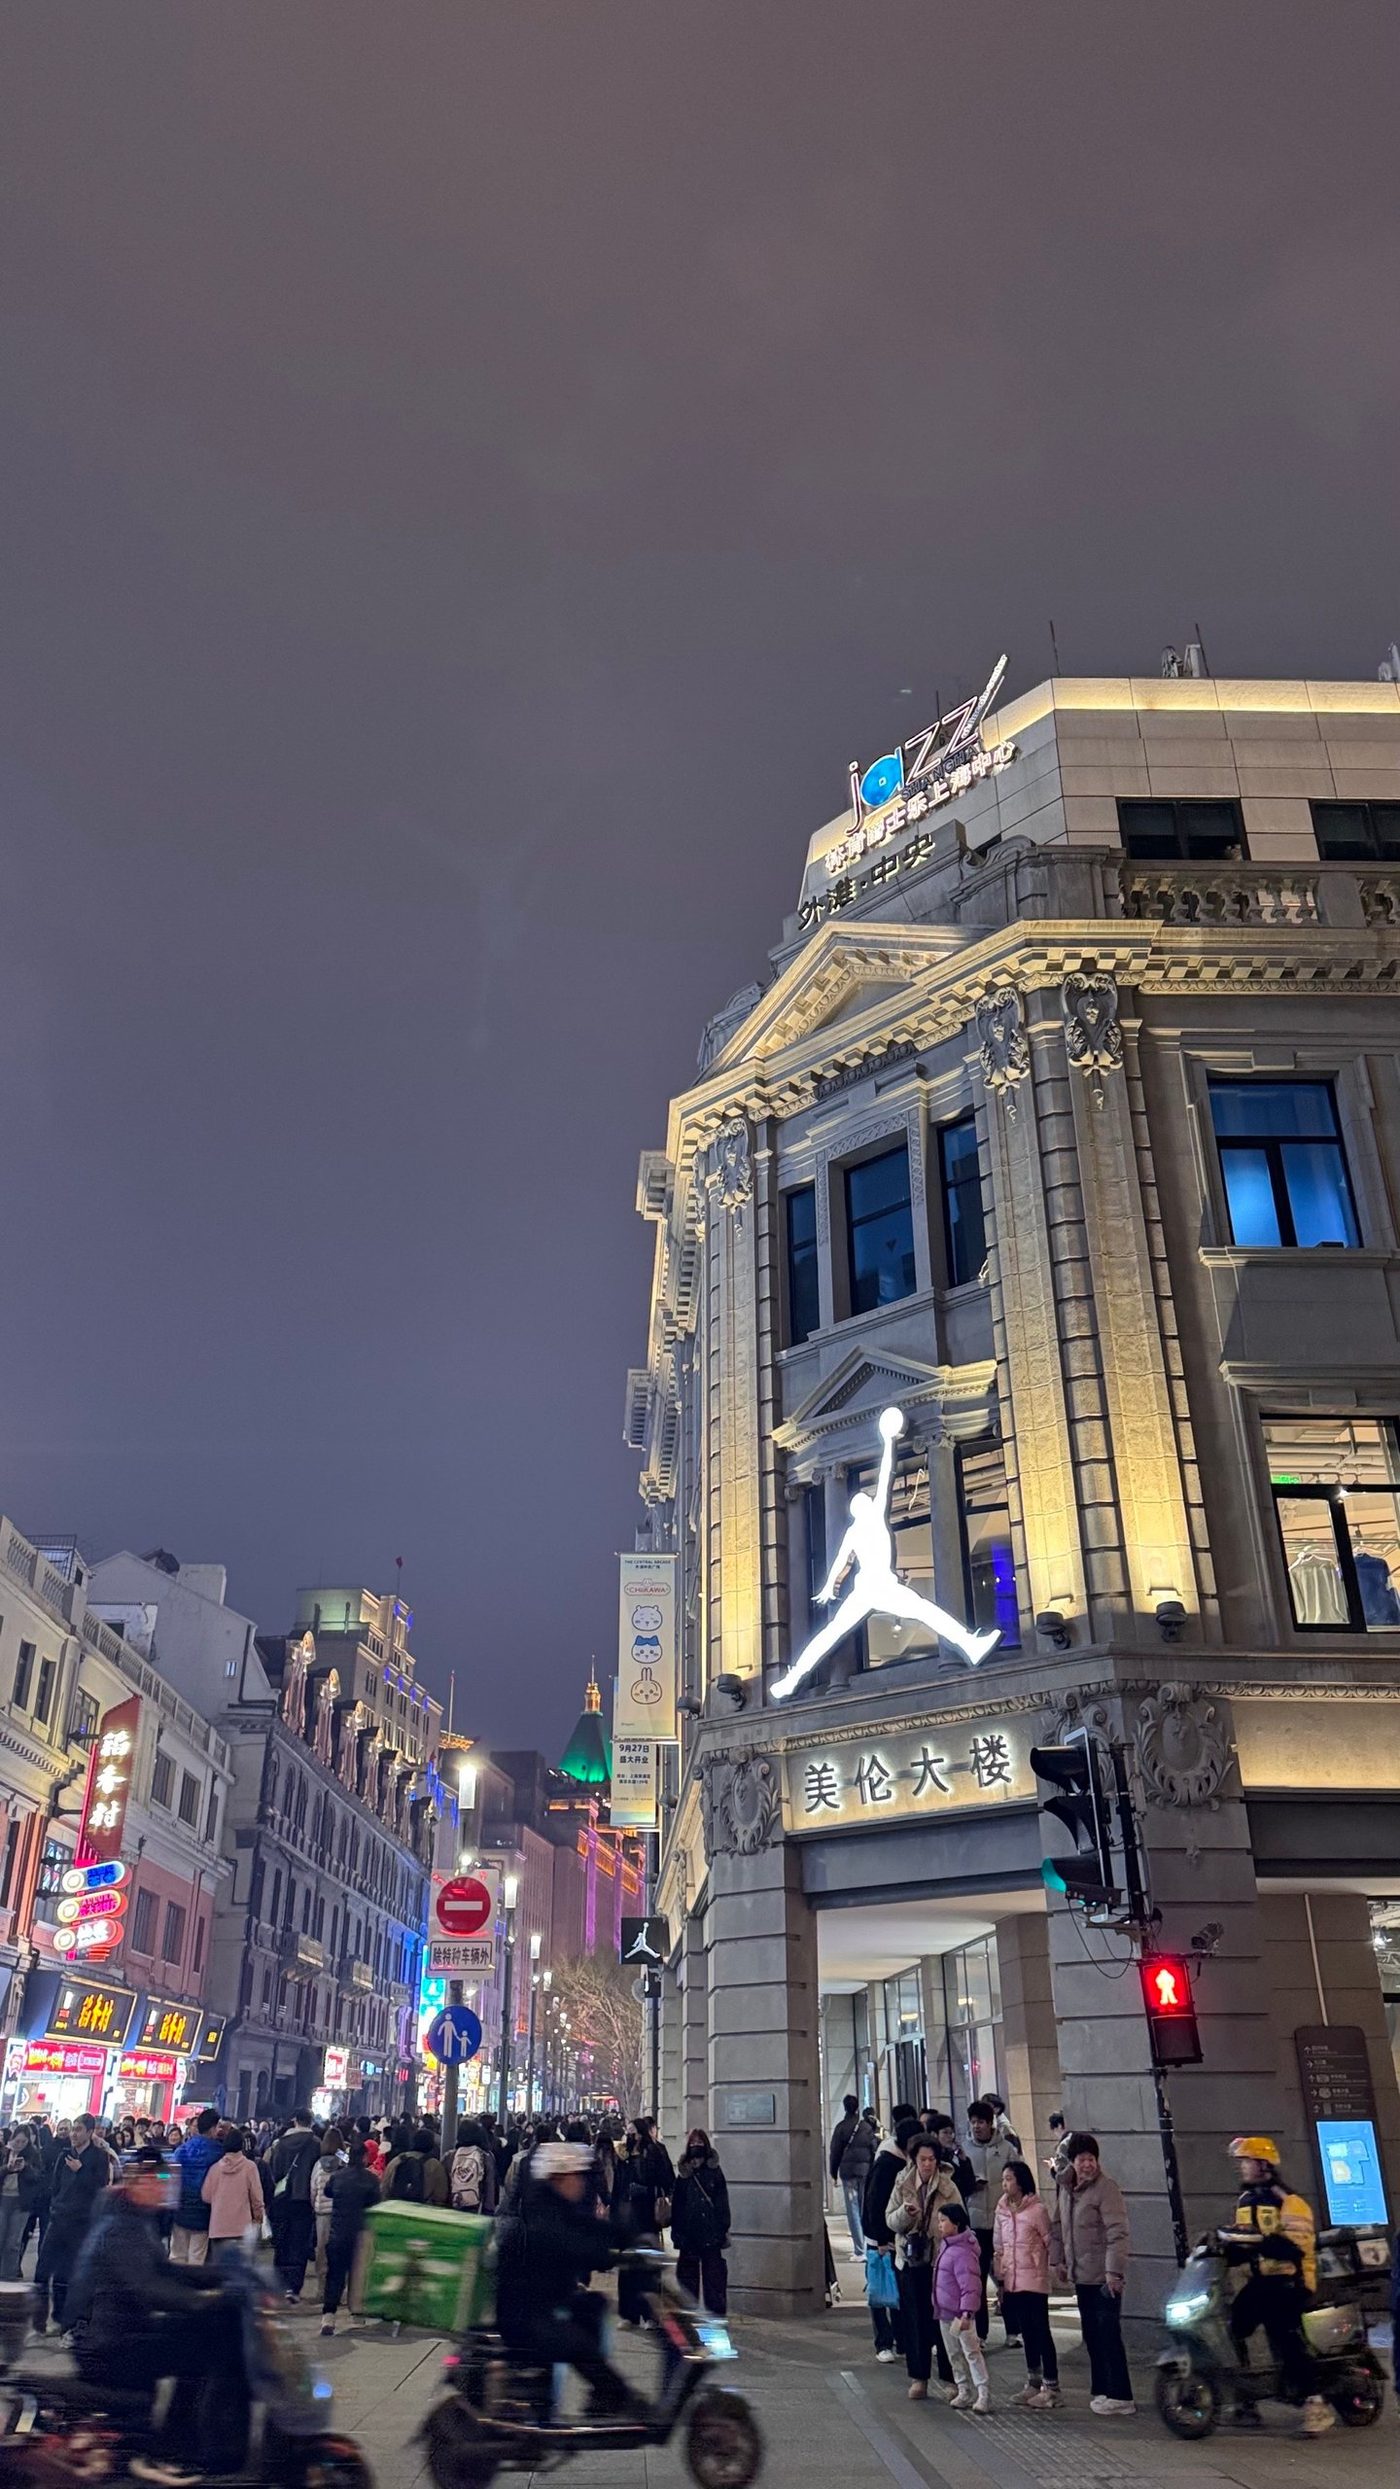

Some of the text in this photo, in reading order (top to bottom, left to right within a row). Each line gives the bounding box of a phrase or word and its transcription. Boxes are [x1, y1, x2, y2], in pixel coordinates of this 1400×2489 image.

[844, 695, 980, 837] jazz
[619, 1744, 649, 1753] 9月27日
[619, 1755, 649, 1764] 盛大开业
[804, 1734, 1013, 1814] 美伦大楼
[432, 1946, 490, 1965] 除特种车辆外
